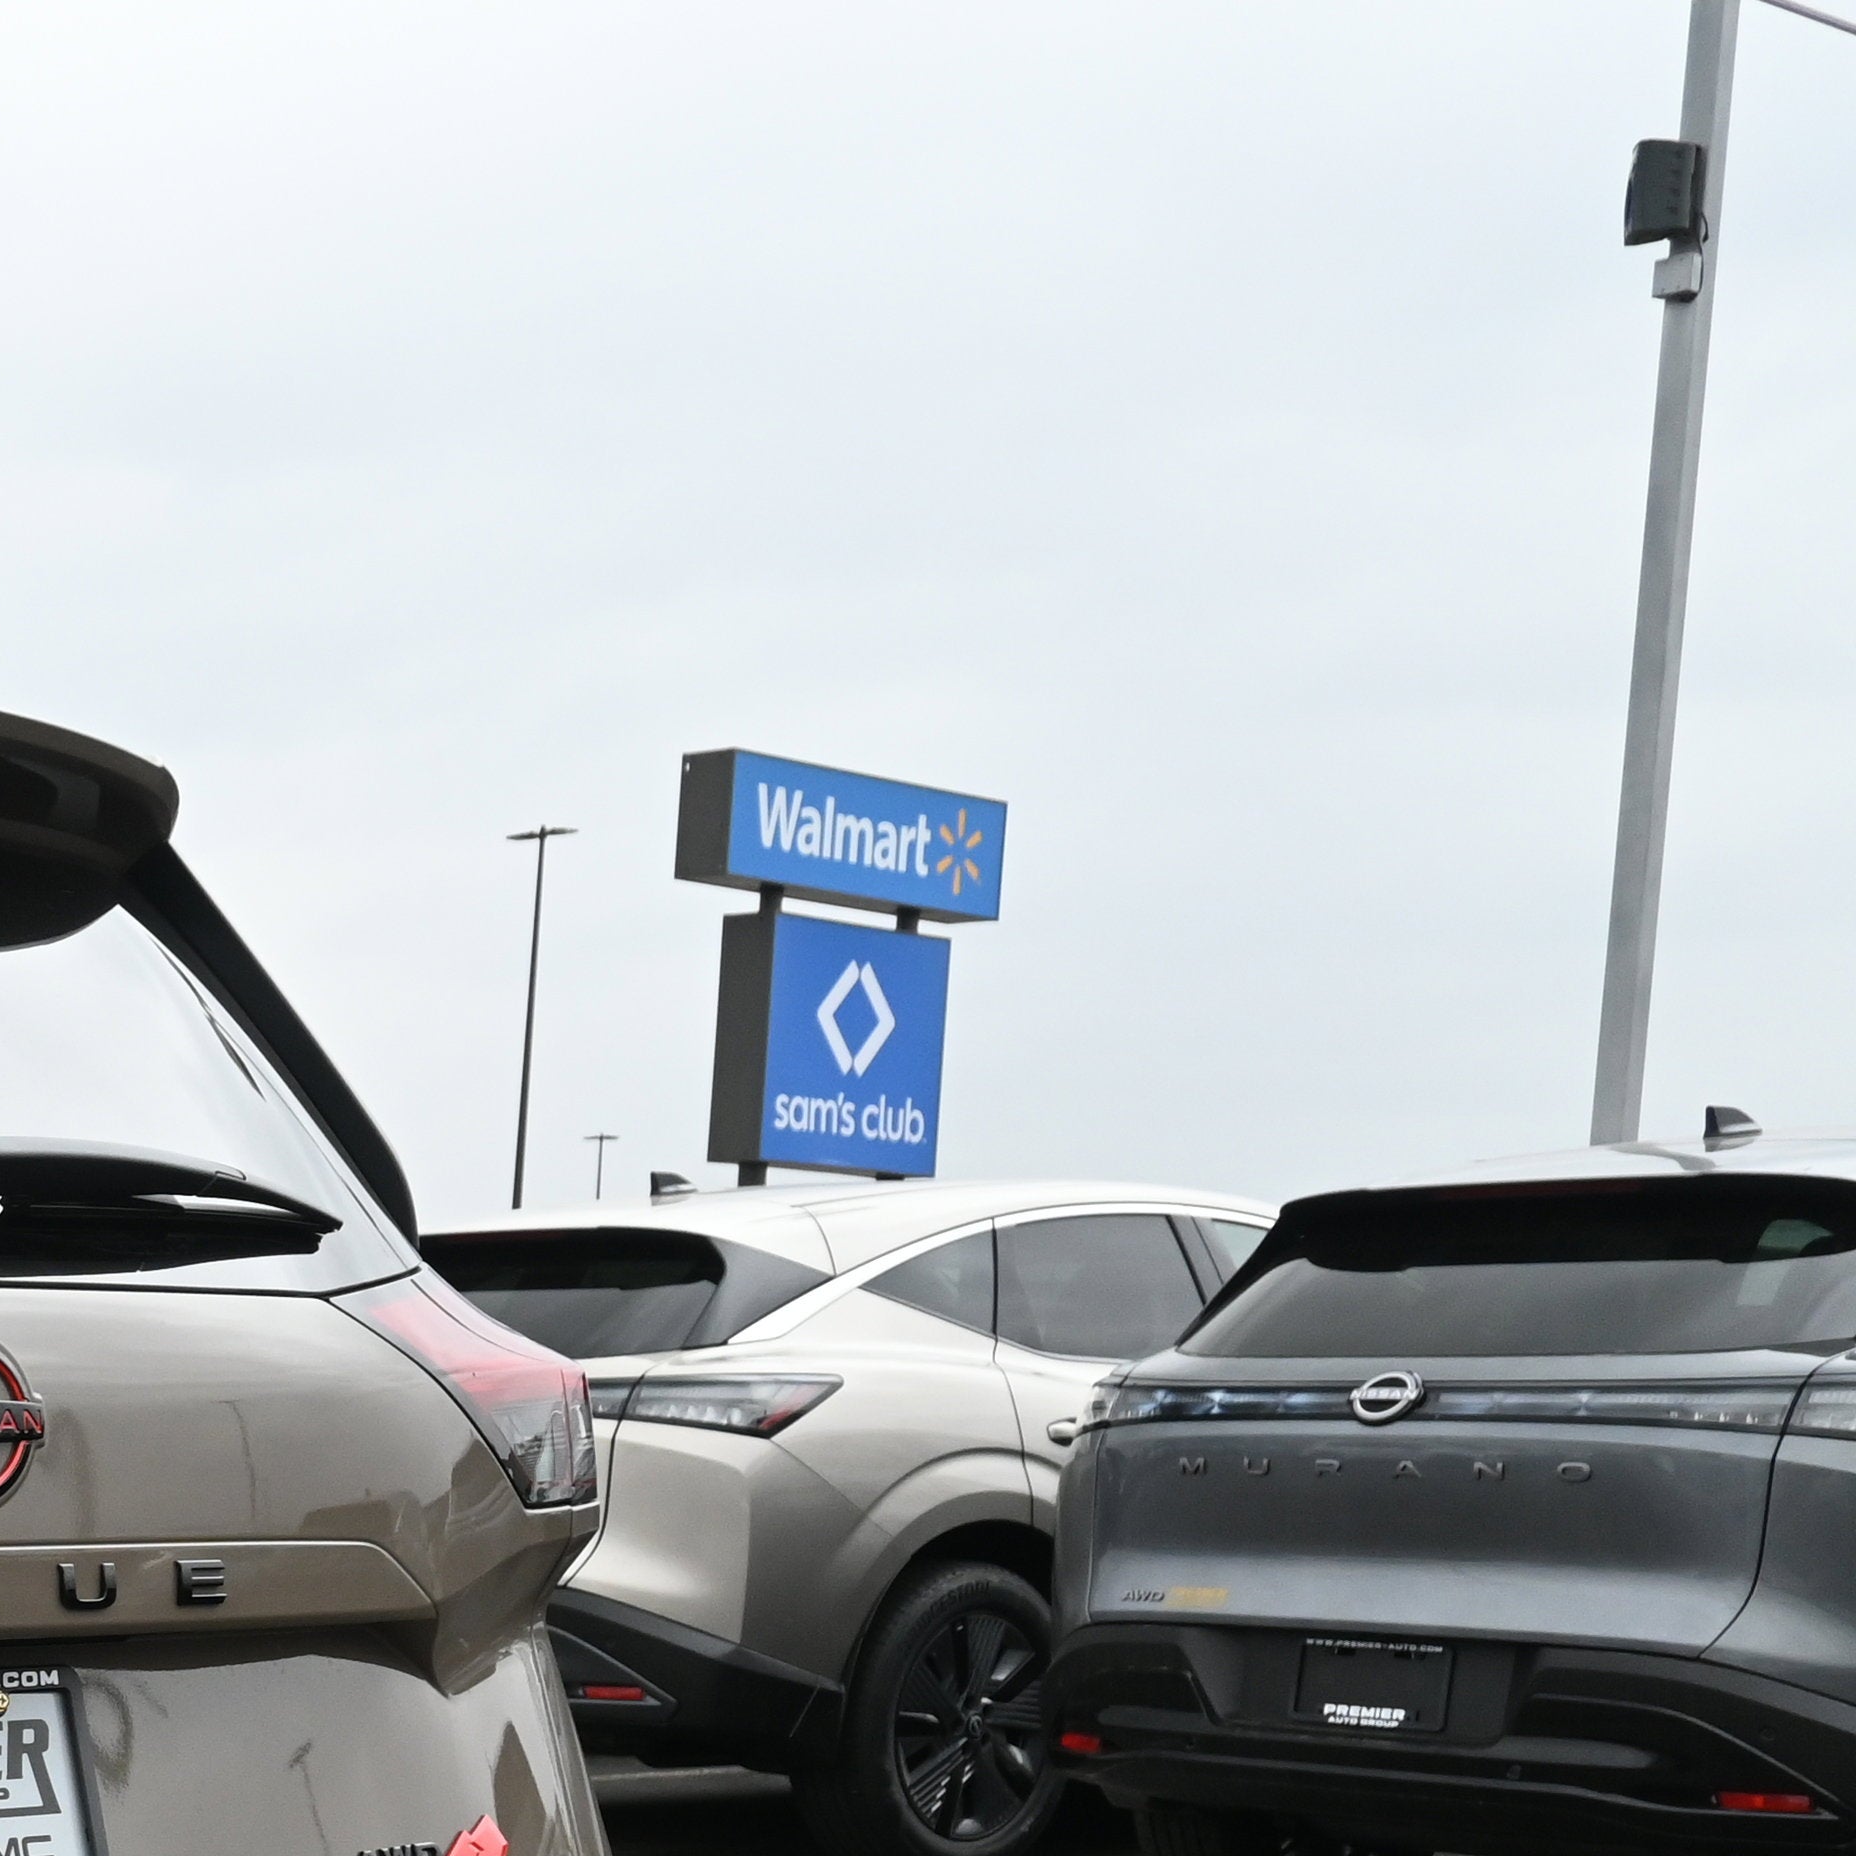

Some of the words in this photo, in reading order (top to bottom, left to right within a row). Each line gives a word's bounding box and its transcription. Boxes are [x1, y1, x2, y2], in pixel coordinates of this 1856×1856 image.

[758, 782, 929, 876] Walmart
[774, 1092, 856, 1137] sam's
[861, 1094, 925, 1144] club
[1179, 1456, 1593, 1483] MURANO
[1122, 1589, 1166, 1602] AWD
[1323, 1703, 1406, 1721] PREMIER
[1327, 1715, 1358, 1726] AUTO
[1360, 1719, 1399, 1728] GROUP
